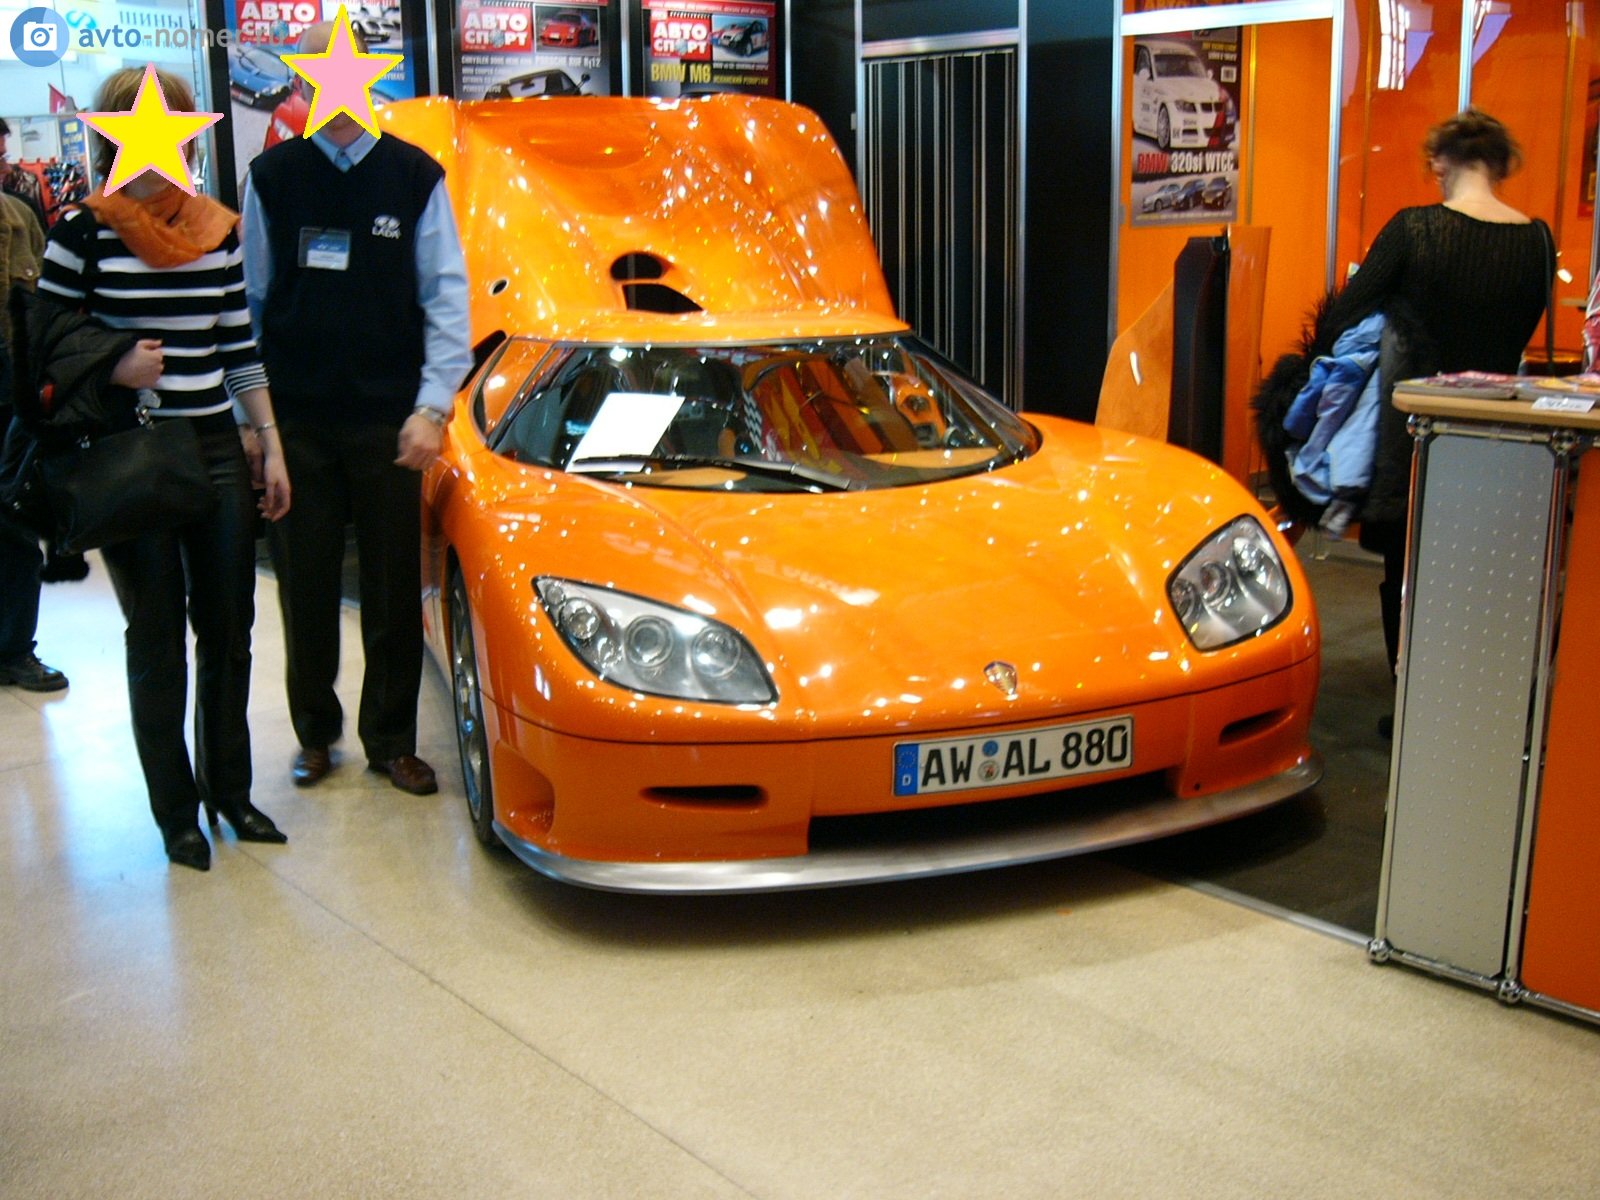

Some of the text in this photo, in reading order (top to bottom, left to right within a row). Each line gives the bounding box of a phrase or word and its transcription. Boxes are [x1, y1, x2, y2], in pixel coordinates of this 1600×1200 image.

[119, 10, 184, 29] ШИНЫ
[241, 2, 316, 22] АВТО
[241, 20, 313, 38] СПОР
[464, 12, 529, 32] АВТО
[653, 21, 708, 41] АВТО
[464, 29, 529, 48] СПОРТ
[653, 38, 708, 55] СПОРТ
[651, 62, 687, 83] BMW
[1136, 152, 1169, 174] BMW
[1204, 152, 1235, 172] WTCC
[372, 225, 400, 240] LADA
[921, 724, 1128, 787] AW AL 880
[901, 774, 912, 786] D
